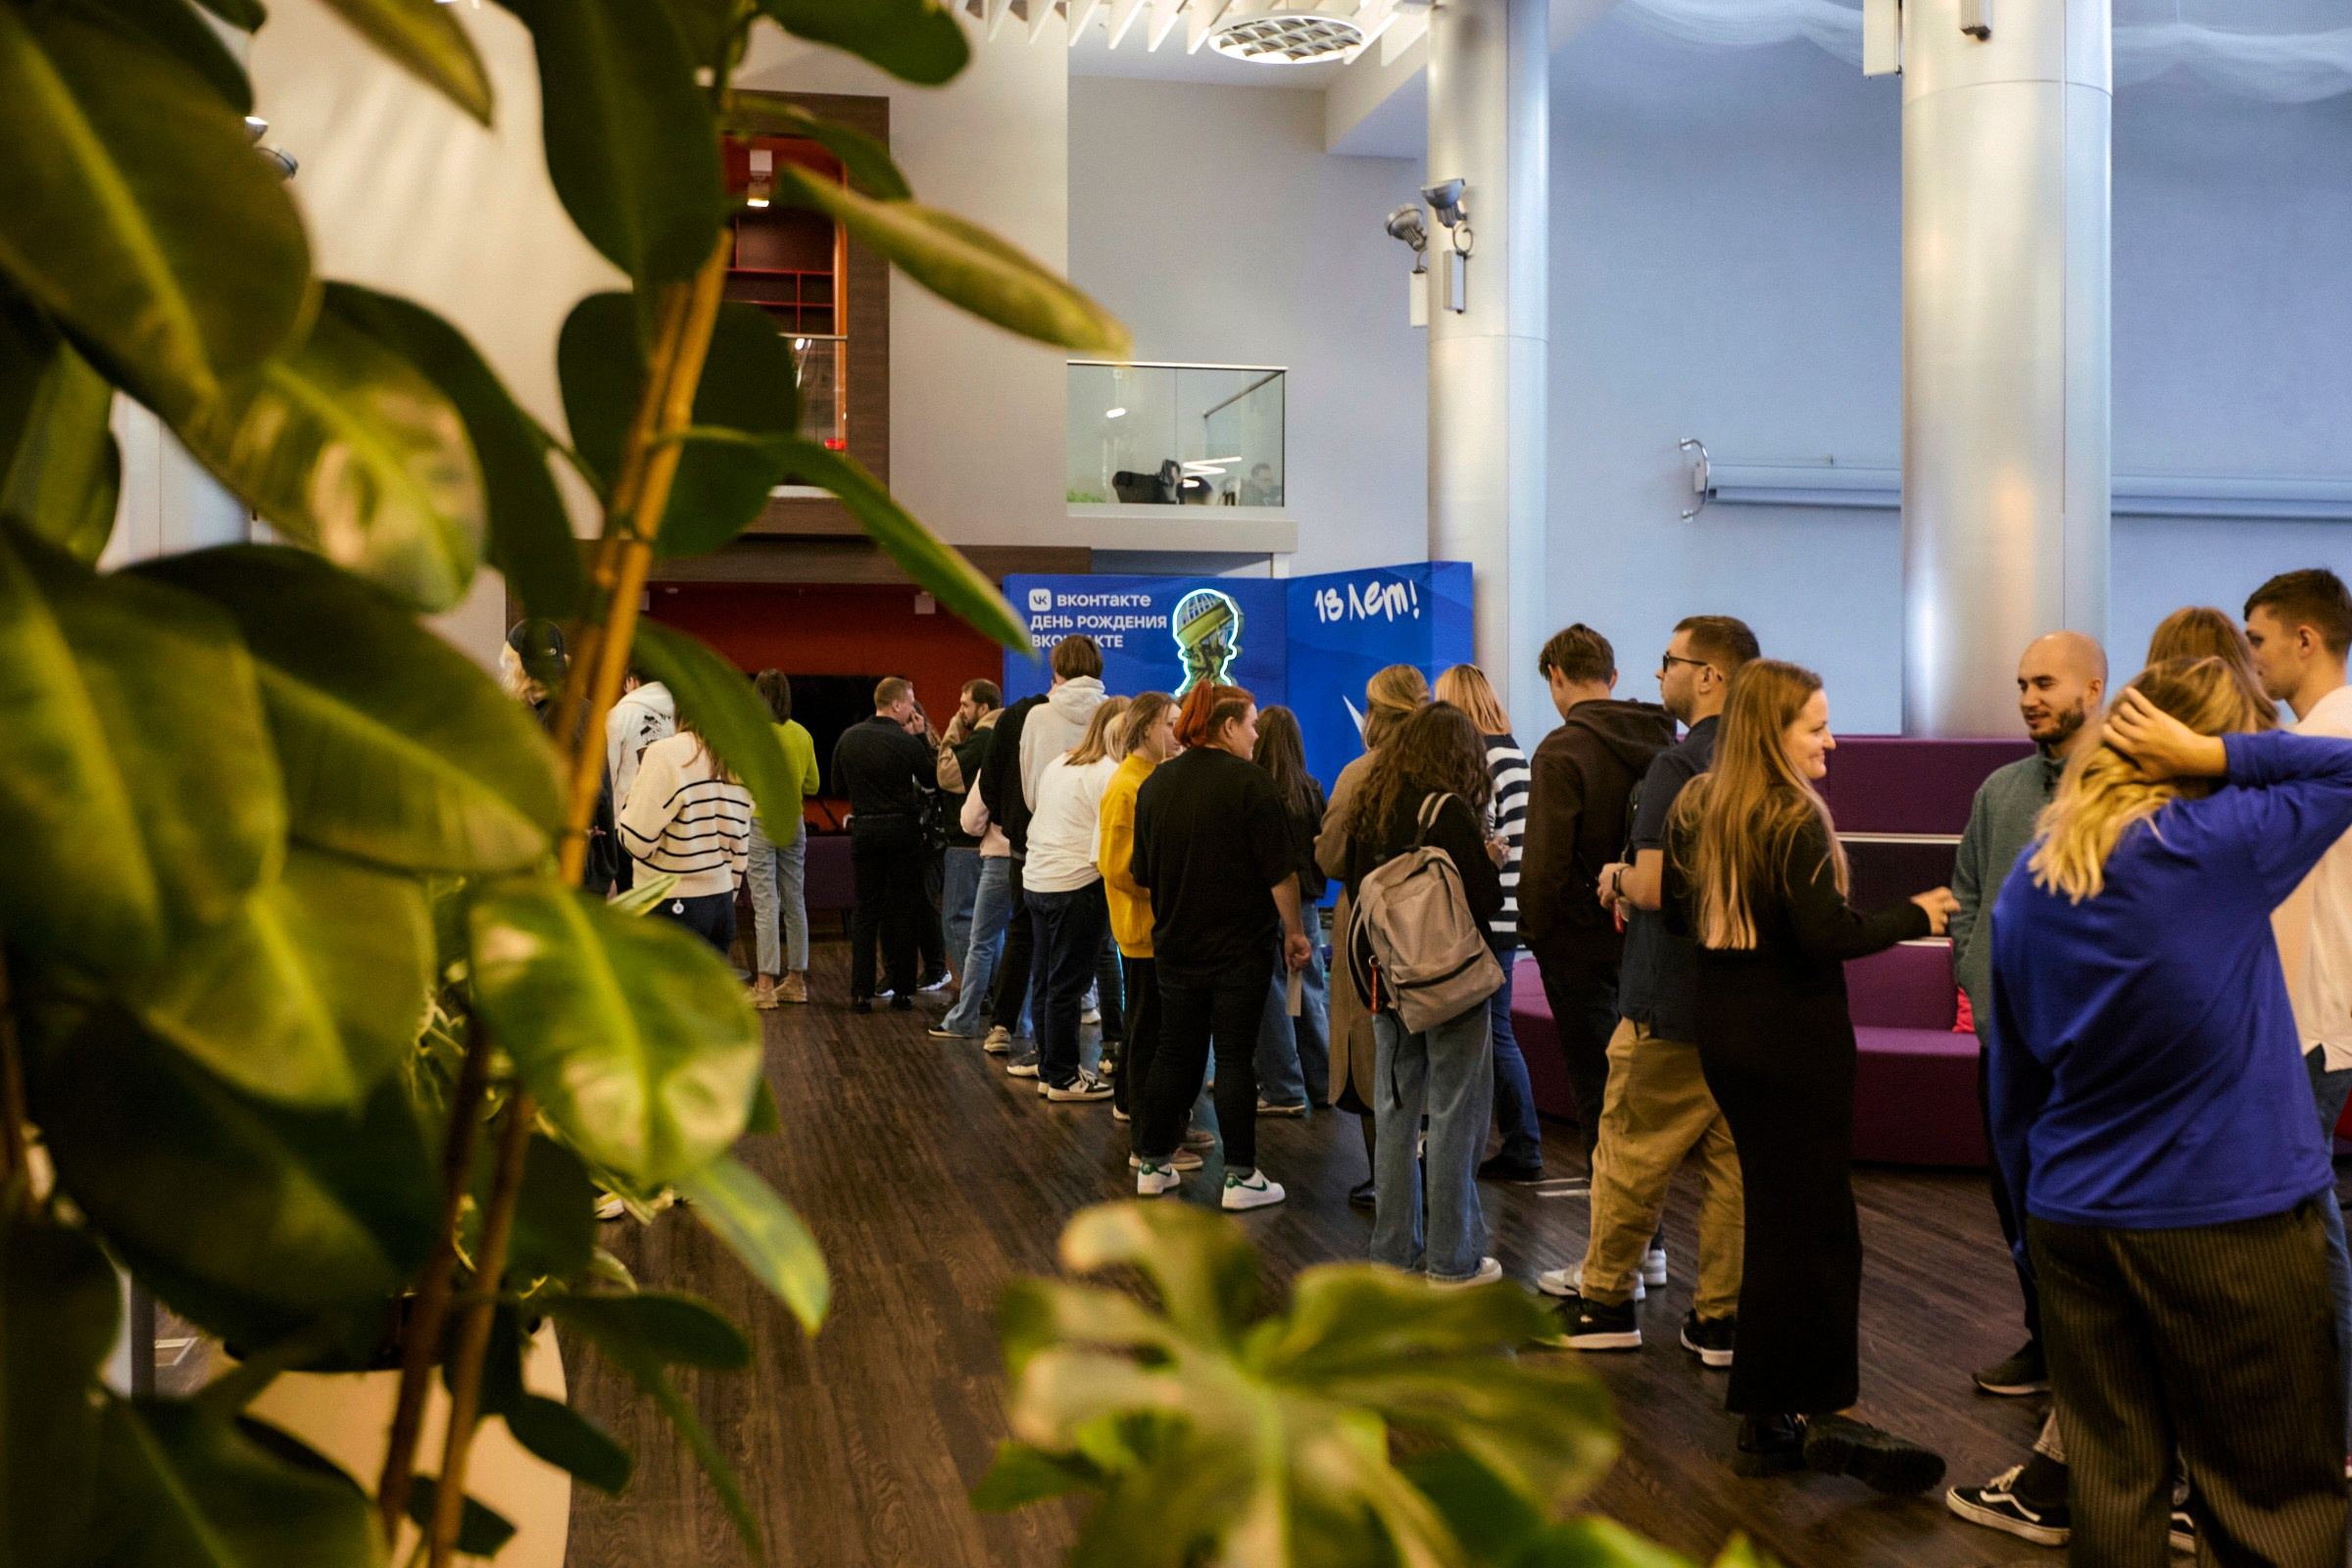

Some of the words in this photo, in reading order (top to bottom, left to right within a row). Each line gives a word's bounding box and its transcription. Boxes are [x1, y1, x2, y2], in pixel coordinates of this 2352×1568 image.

[1314, 588, 1345, 623] 18
[1030, 614, 1074, 631] ДЕНЬ
[1077, 614, 1167, 631] РОЖДЕНИЯ
[1031, 634, 1124, 648] ВКОКТЕ
